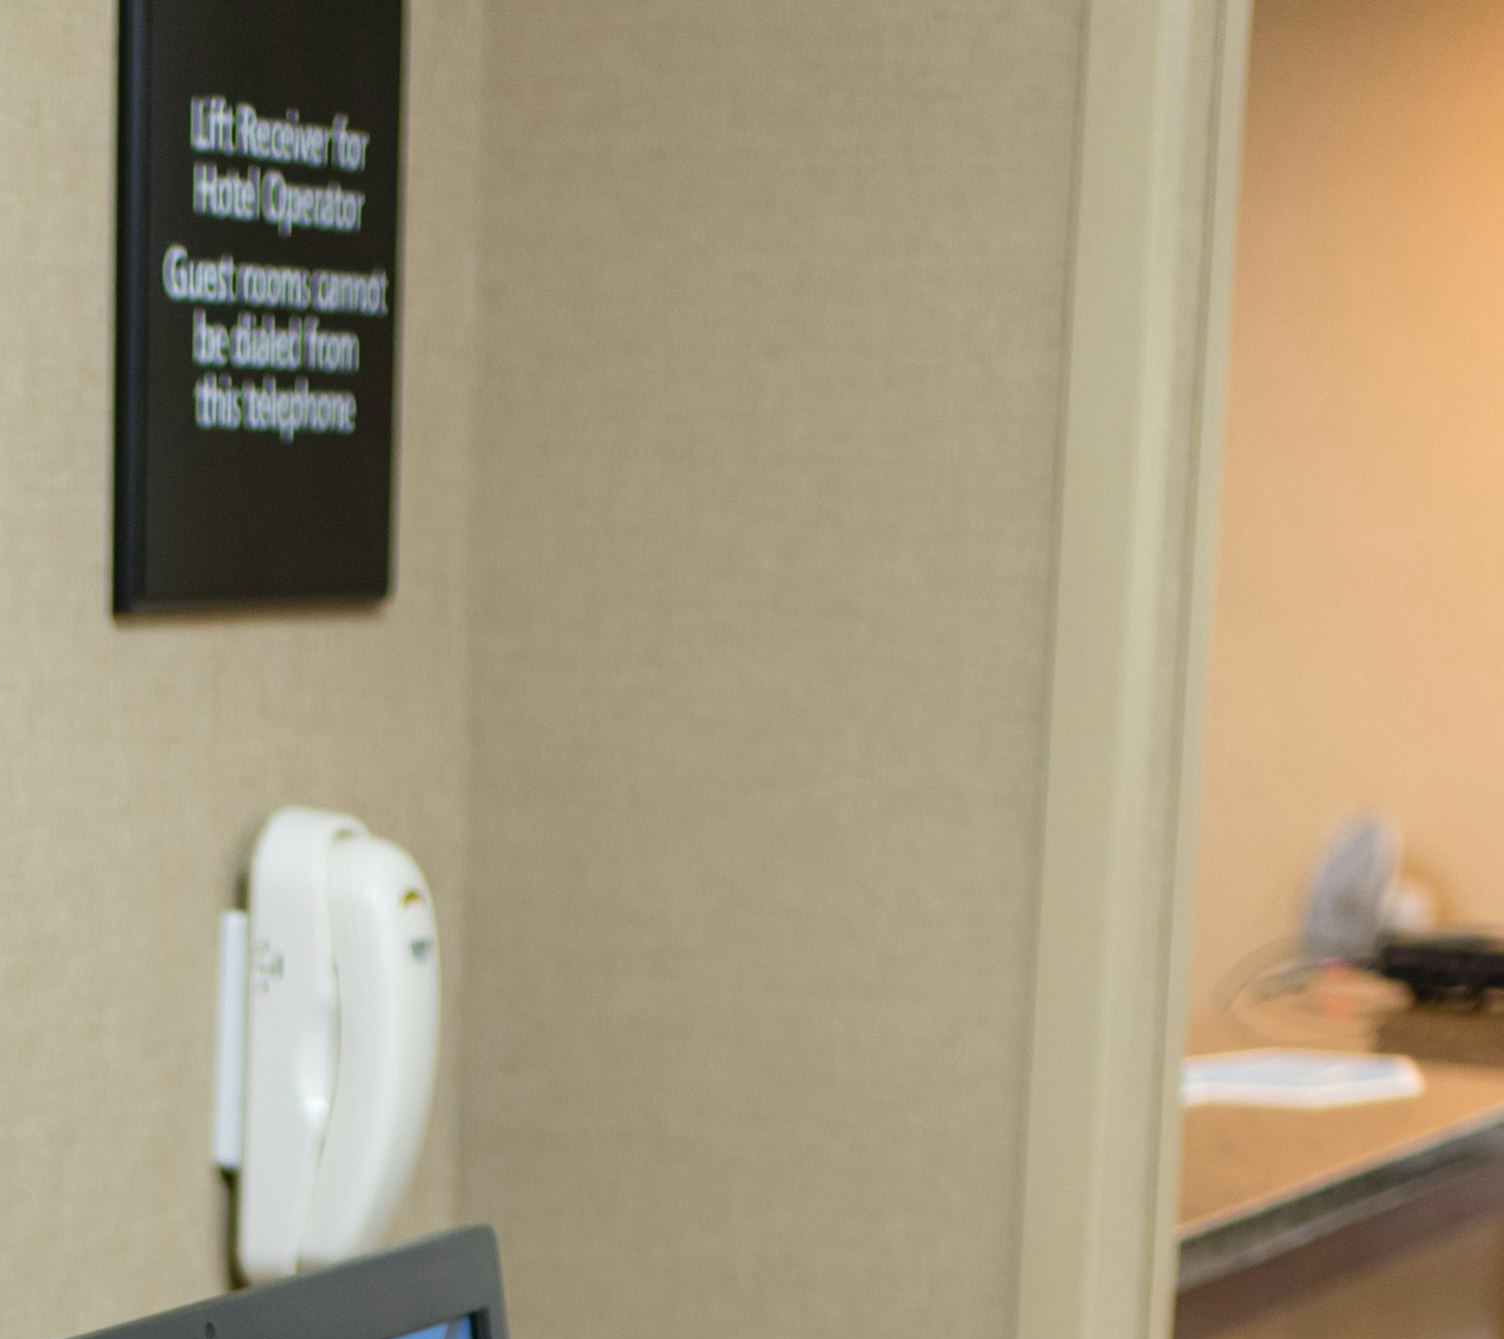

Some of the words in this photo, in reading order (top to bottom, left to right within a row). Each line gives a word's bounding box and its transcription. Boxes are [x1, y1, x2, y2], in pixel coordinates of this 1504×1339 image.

[191, 97, 233, 153] Lift
[236, 102, 329, 167] Receiver
[331, 113, 369, 172] for
[193, 162, 260, 221] Hotel
[262, 169, 365, 236] Operator
[163, 245, 237, 302] Guest
[238, 264, 311, 310] rooms
[312, 268, 388, 317] cannot
[193, 308, 229, 367] be
[230, 312, 302, 370] dialed
[304, 315, 359, 373] from
[194, 373, 242, 430] this
[243, 375, 357, 443] telephone
